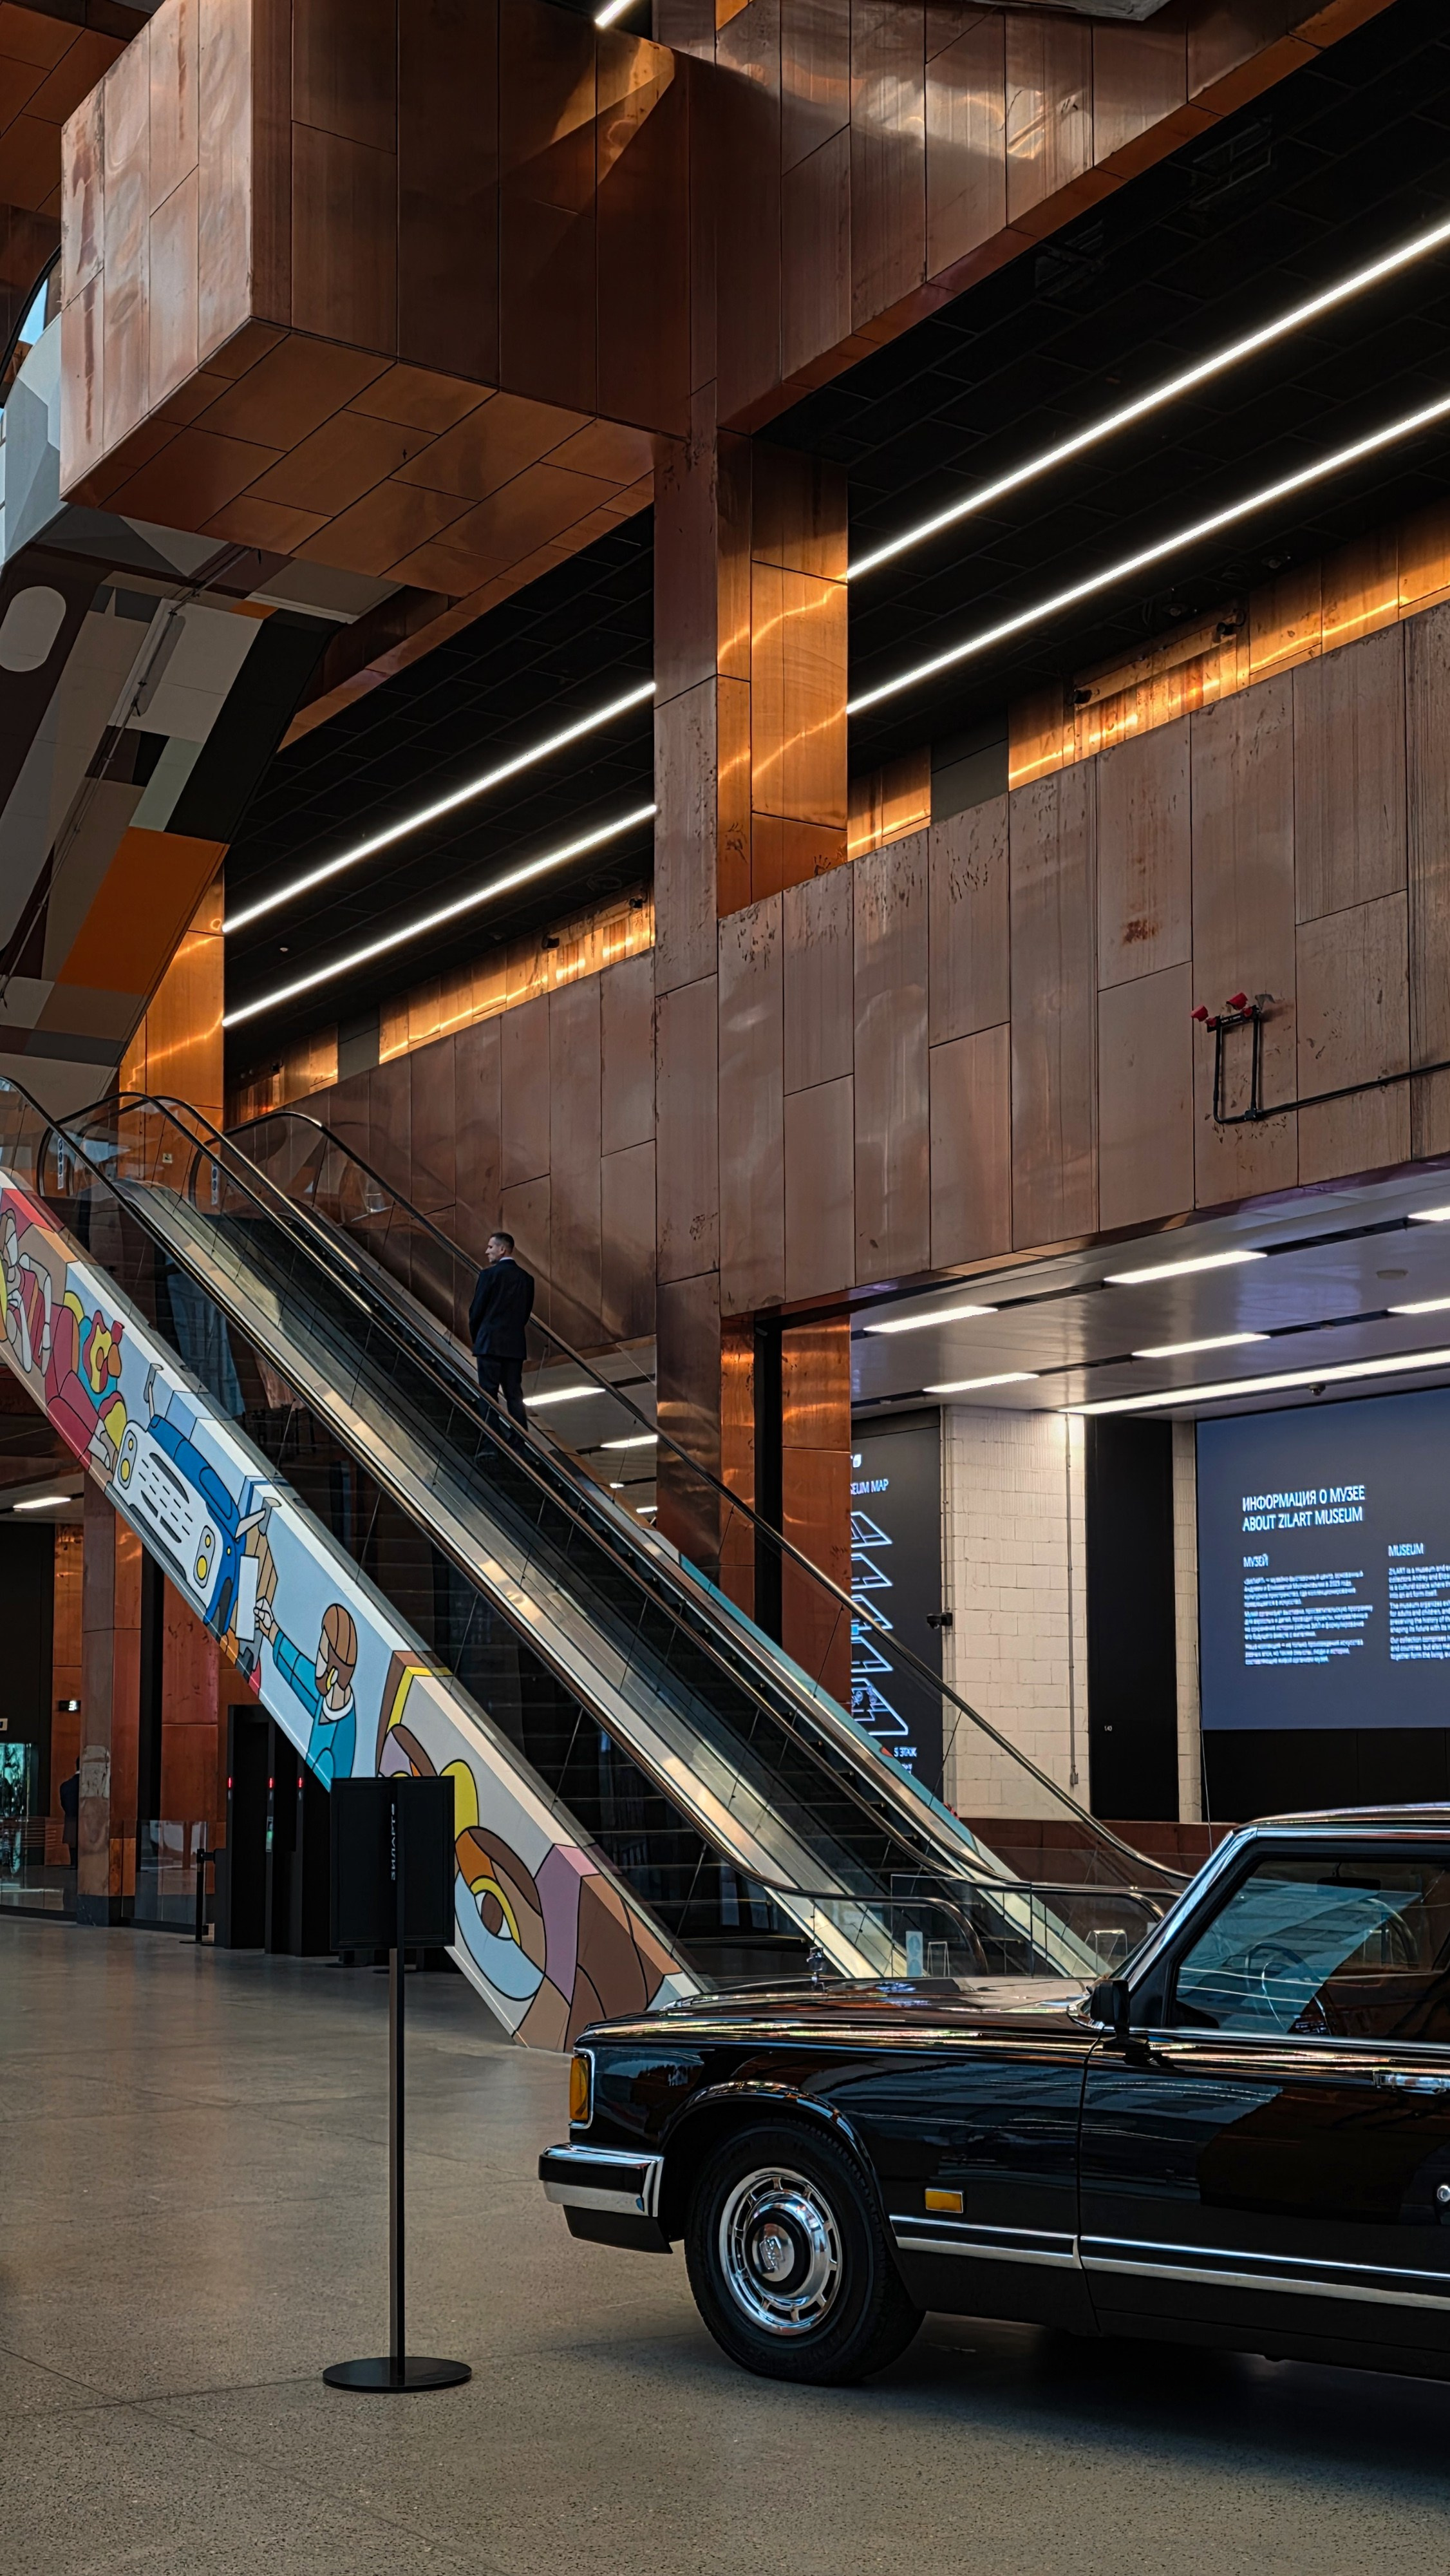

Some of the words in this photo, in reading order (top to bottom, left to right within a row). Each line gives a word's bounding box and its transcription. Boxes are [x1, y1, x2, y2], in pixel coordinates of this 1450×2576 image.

[871, 1479, 889, 1492] MAP
[1242, 1490, 1316, 1511] ИНФОРМАЦИЯ
[1319, 1489, 1328, 1504] О
[1330, 1485, 1365, 1503] МУЗЕЕ
[1242, 1514, 1276, 1531] ABOUT
[1278, 1511, 1313, 1529] ZILART
[1315, 1506, 1362, 1525] MUSEUM
[1388, 1542, 1424, 1557] MUSEUM
[1243, 1553, 1268, 1567] МУЗЕЙ
